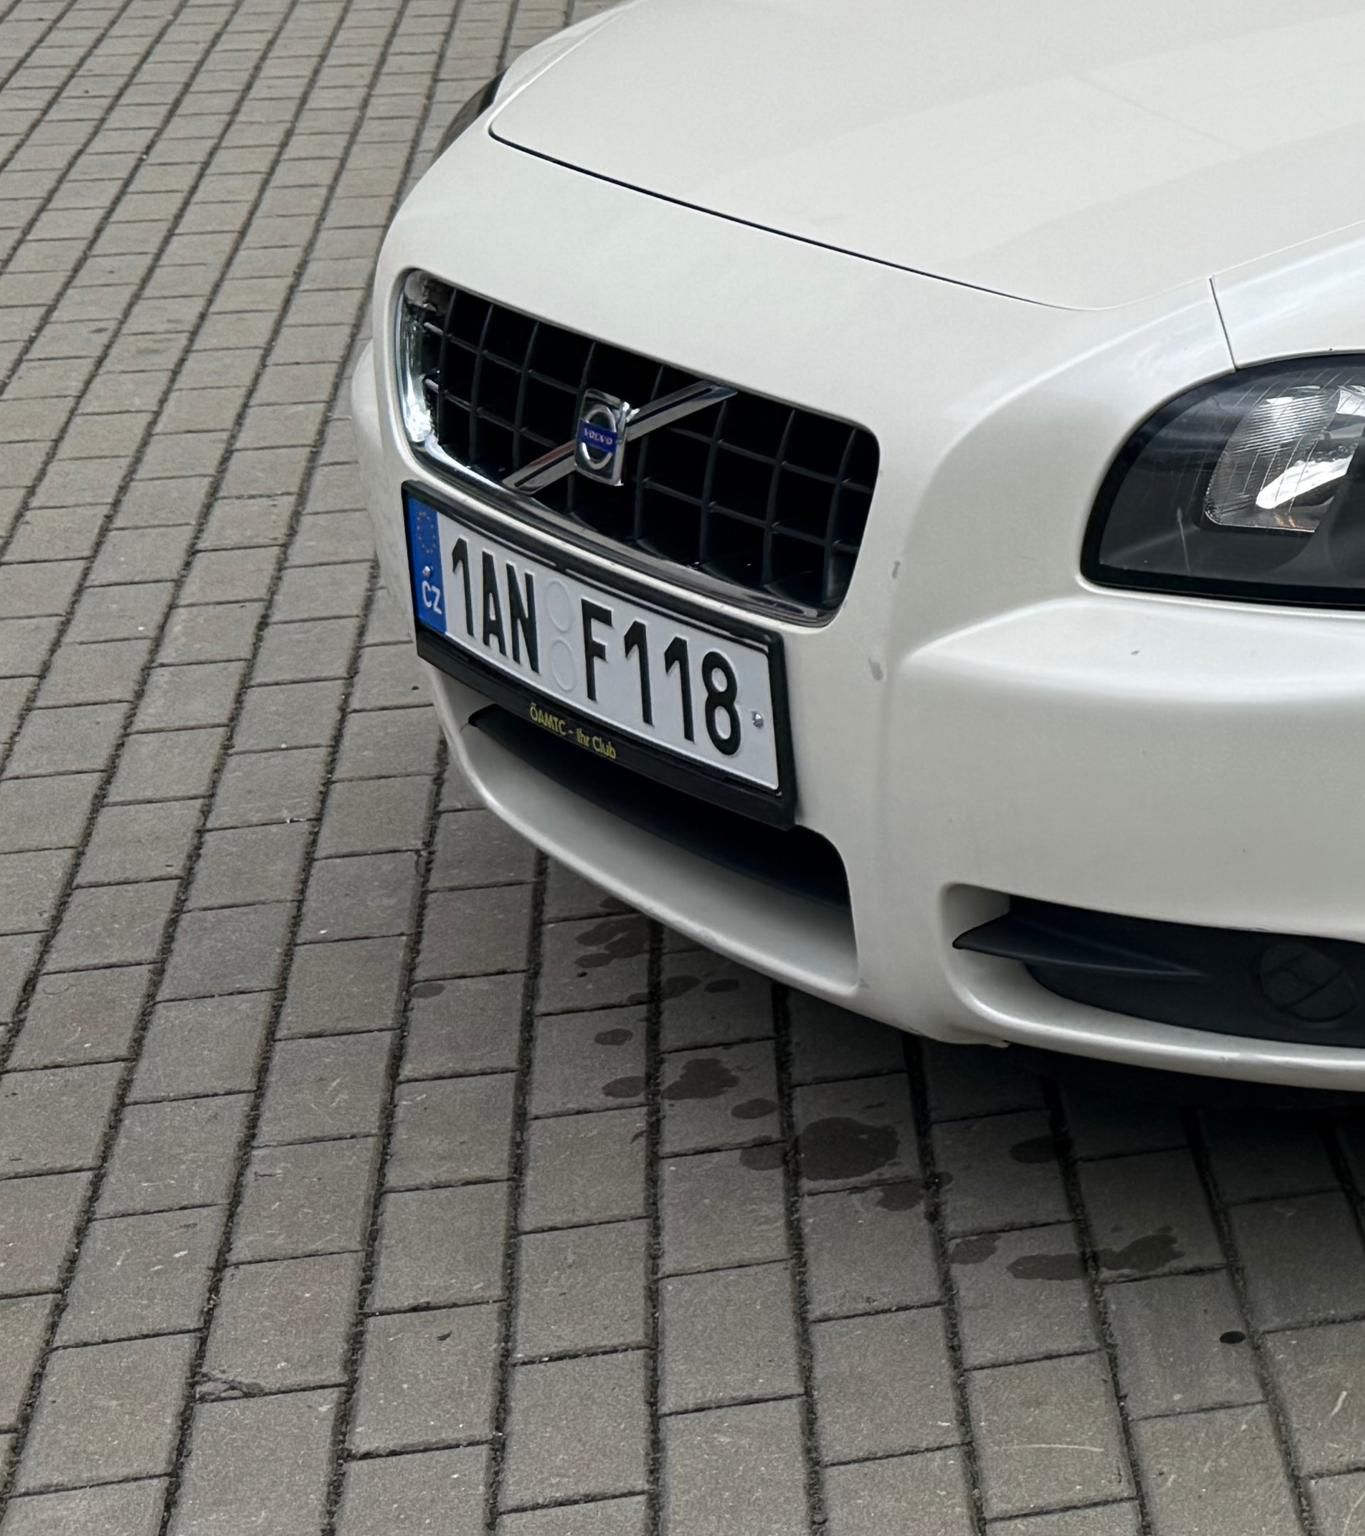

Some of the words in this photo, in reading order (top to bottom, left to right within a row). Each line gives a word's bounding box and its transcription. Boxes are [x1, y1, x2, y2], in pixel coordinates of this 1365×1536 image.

[421, 579, 443, 615] CZ
[451, 537, 540, 675] 1AN
[580, 598, 743, 756] F118
[529, 702, 567, 736] ÖAMTC
[576, 727, 591, 748] Ihr
[592, 735, 617, 760] Club
